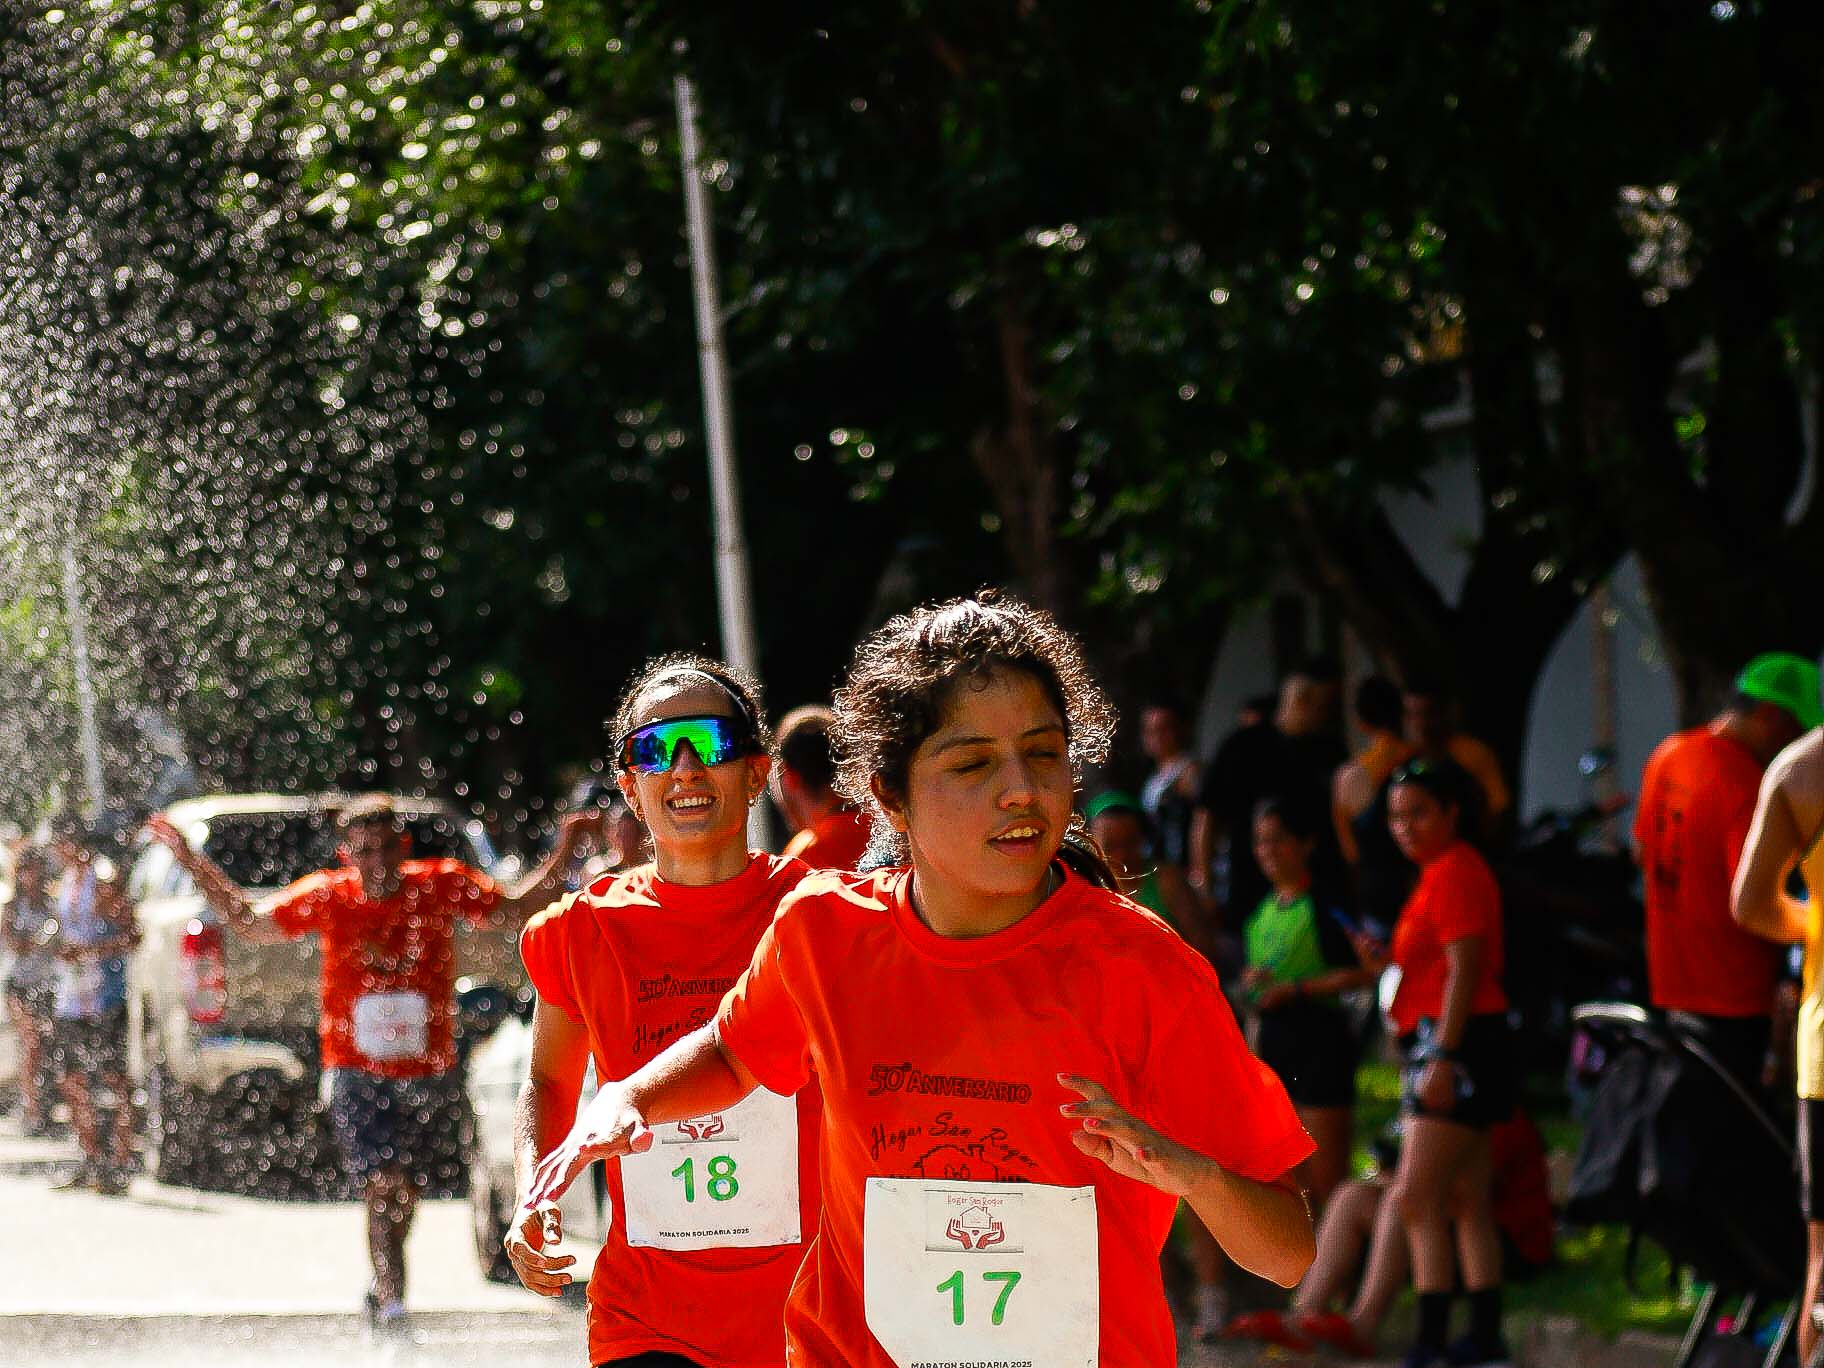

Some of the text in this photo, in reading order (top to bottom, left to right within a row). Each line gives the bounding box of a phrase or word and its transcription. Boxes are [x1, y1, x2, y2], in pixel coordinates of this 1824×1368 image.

[905, 1069, 1032, 1104] ANIVERSARIO
[672, 1155, 739, 1203] 18
[692, 1229, 732, 1237] SOLIDARIA
[732, 1227, 751, 1235] 2025
[936, 1270, 1022, 1326] 17
[959, 1361, 1009, 1368] SOLIDARIA
[1010, 1360, 1033, 1368] 2025
